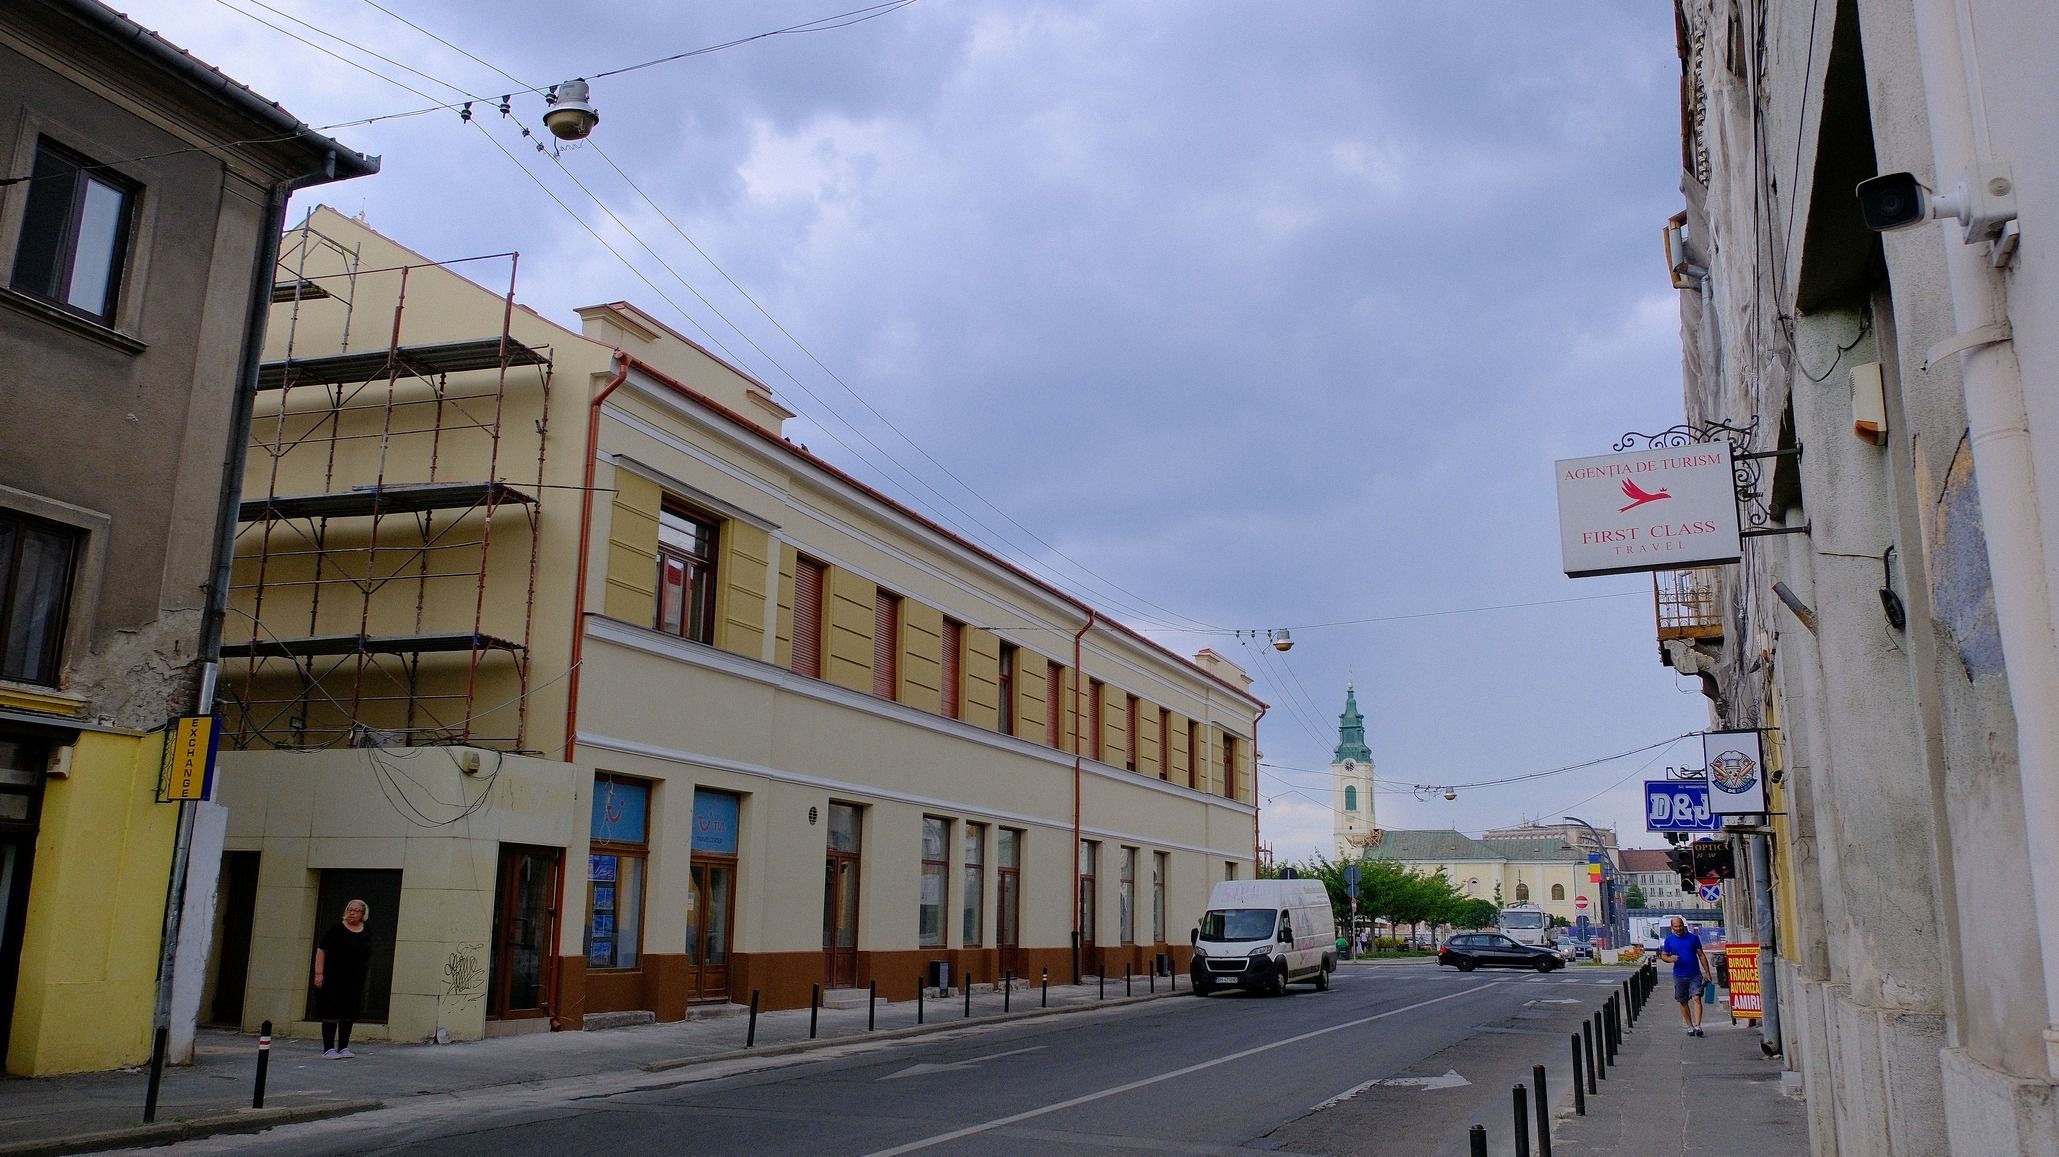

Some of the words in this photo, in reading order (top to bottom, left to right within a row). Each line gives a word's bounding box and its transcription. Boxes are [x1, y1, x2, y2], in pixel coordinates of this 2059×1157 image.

[1636, 461, 1656, 473] DE
[1662, 454, 1721, 471] TURISM
[1583, 527, 1639, 544] FIRST
[1650, 520, 1716, 537] CLASS
[1615, 541, 1686, 555] TRAVEL
[182, 719, 199, 797] EXCHANGE
[1729, 957, 1753, 968] BIROUL
[1729, 968, 1759, 981] TRADUCE
[1731, 981, 1760, 994] AUTORIZA
[1732, 994, 1760, 1010] AMIRI
